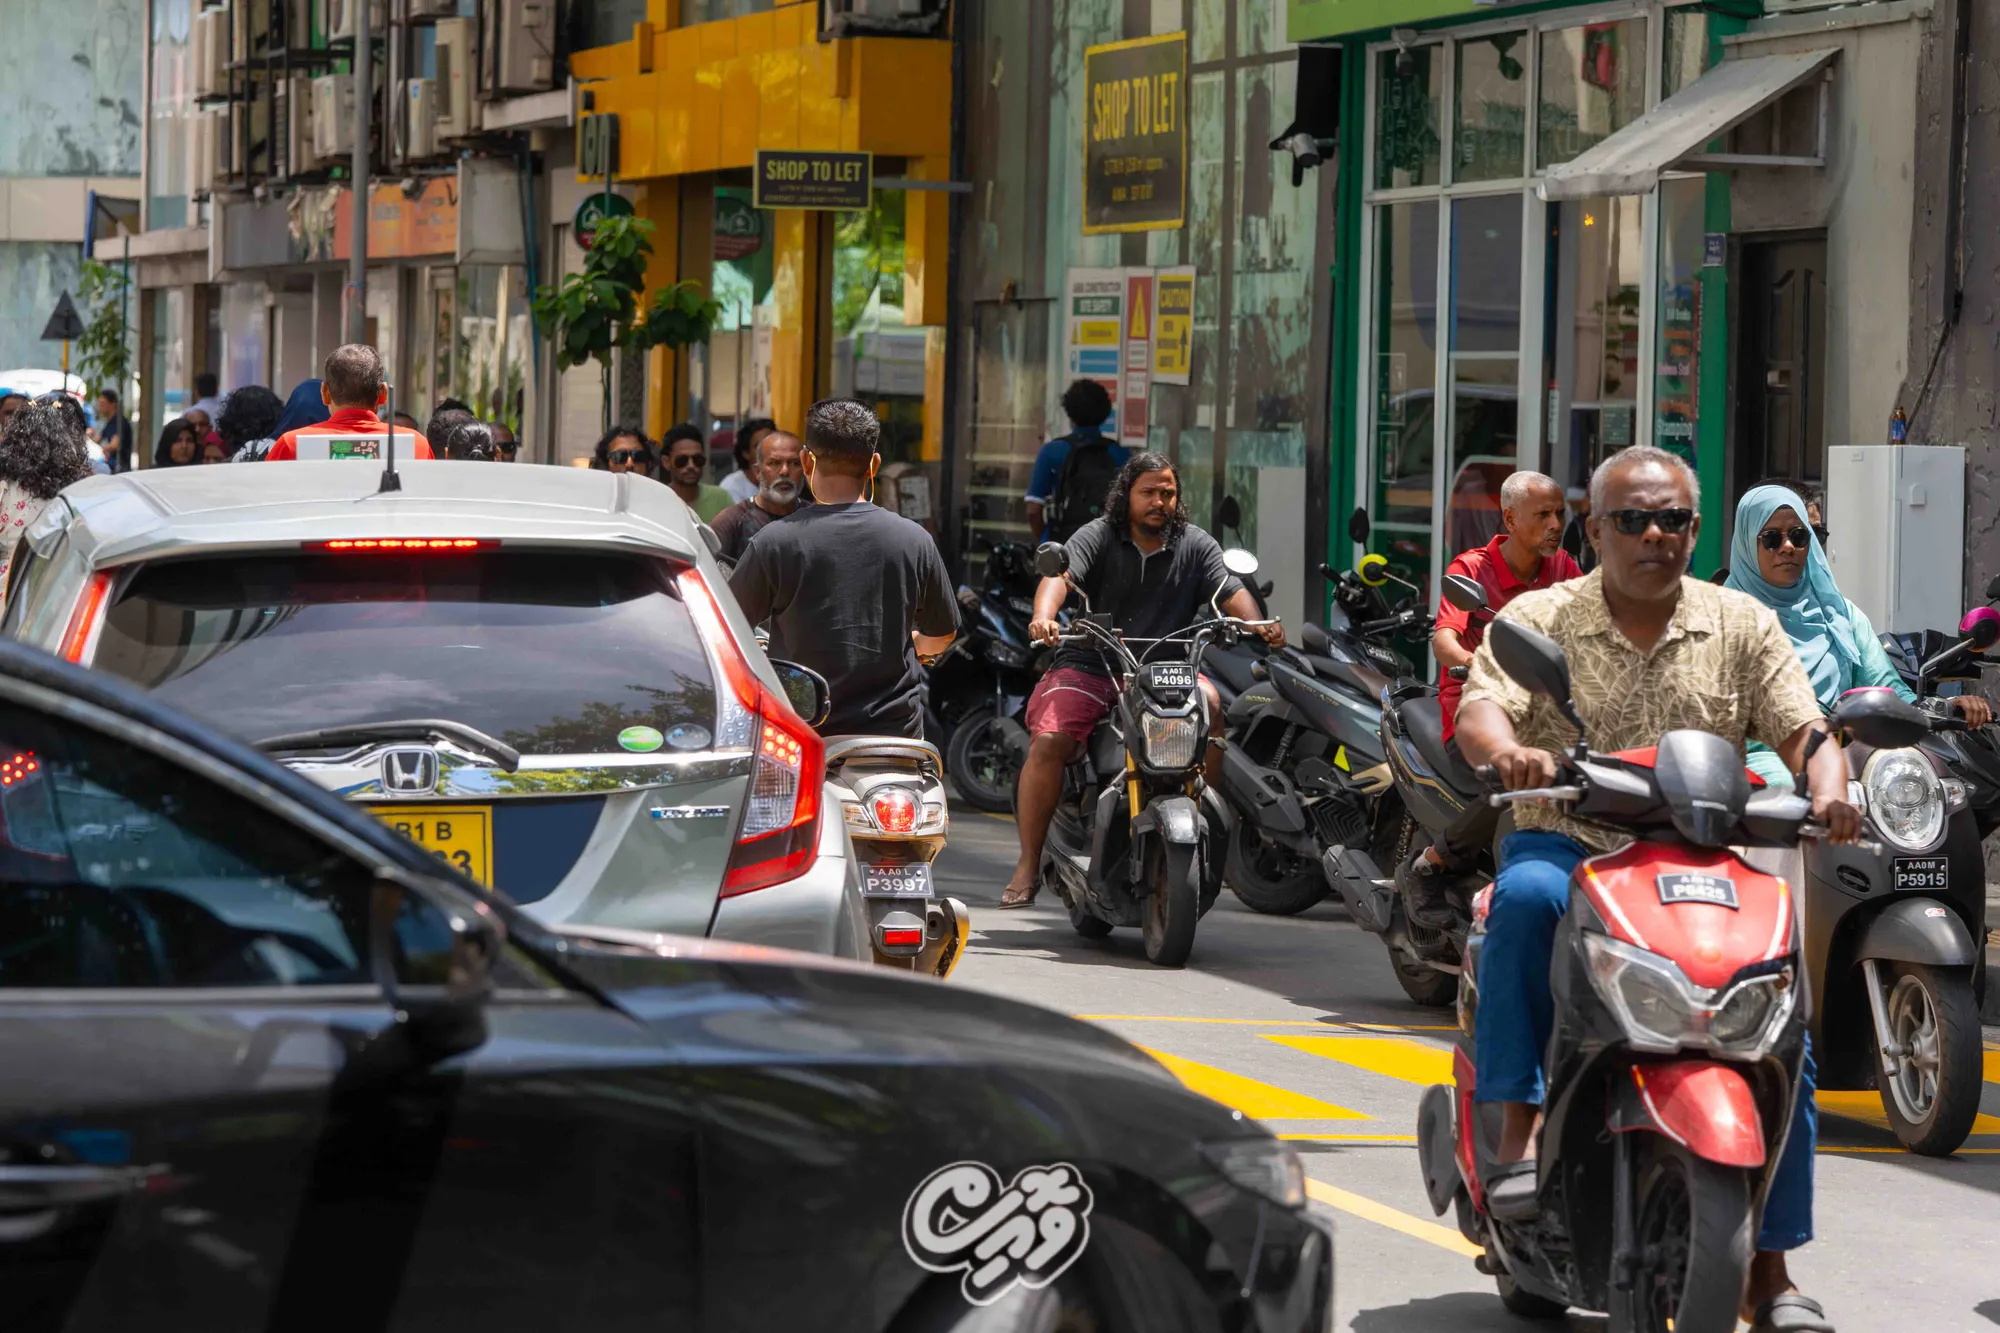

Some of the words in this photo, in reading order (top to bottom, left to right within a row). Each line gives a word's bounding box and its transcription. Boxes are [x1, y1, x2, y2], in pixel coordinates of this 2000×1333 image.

[1093, 79, 1130, 141] SHOP
[1133, 76, 1150, 136] TO
[1153, 72, 1177, 134] LET
[766, 160, 808, 180] SHOP
[811, 161, 831, 181] TO
[835, 162, 862, 182] LET
[1160, 288, 1191, 308] CAUTION
[1656, 418, 1692, 440] Stamping
[1154, 675, 1192, 685] P4096
[867, 878, 927, 891] P3997
[1897, 873, 1945, 886] P5915
